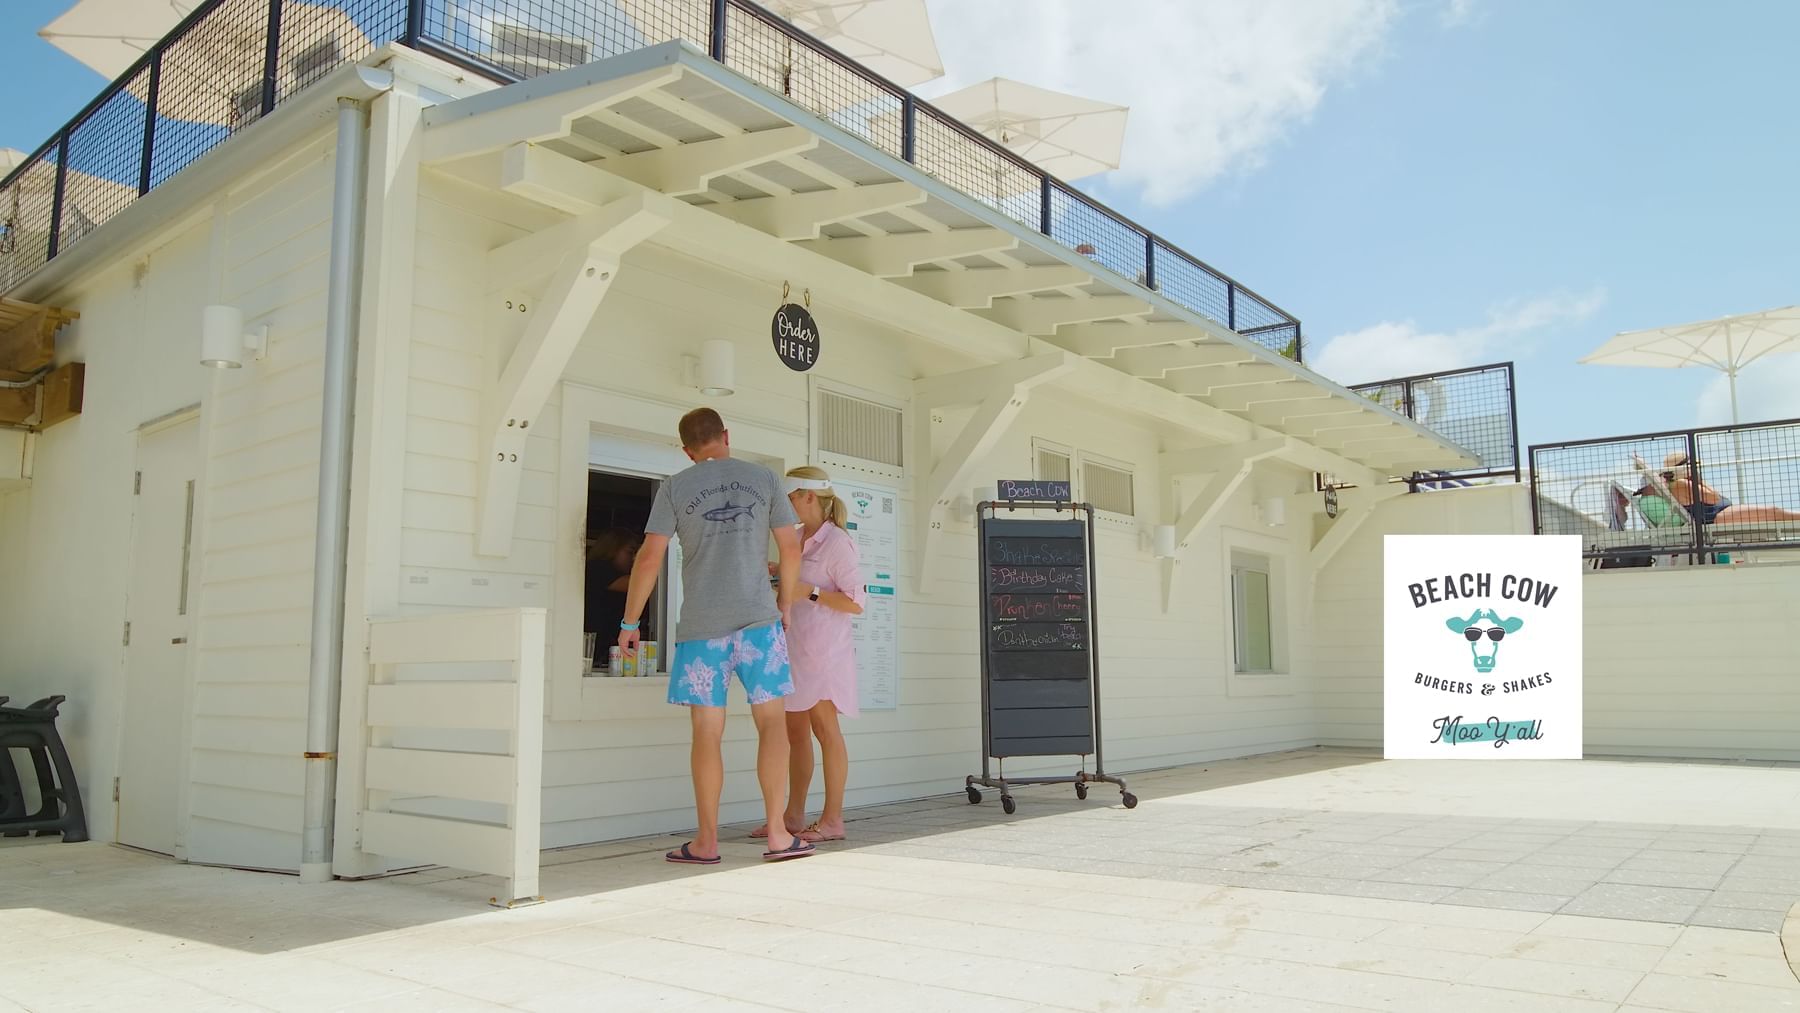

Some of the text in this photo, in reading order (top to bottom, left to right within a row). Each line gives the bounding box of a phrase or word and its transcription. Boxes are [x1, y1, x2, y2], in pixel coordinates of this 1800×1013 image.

[778, 312, 815, 343] Order
[780, 338, 812, 364] HERE
[685, 481, 766, 515] Old Florida Outfitters
[1002, 481, 1044, 498] Beach
[1000, 567, 1073, 587] Birthday Cake
